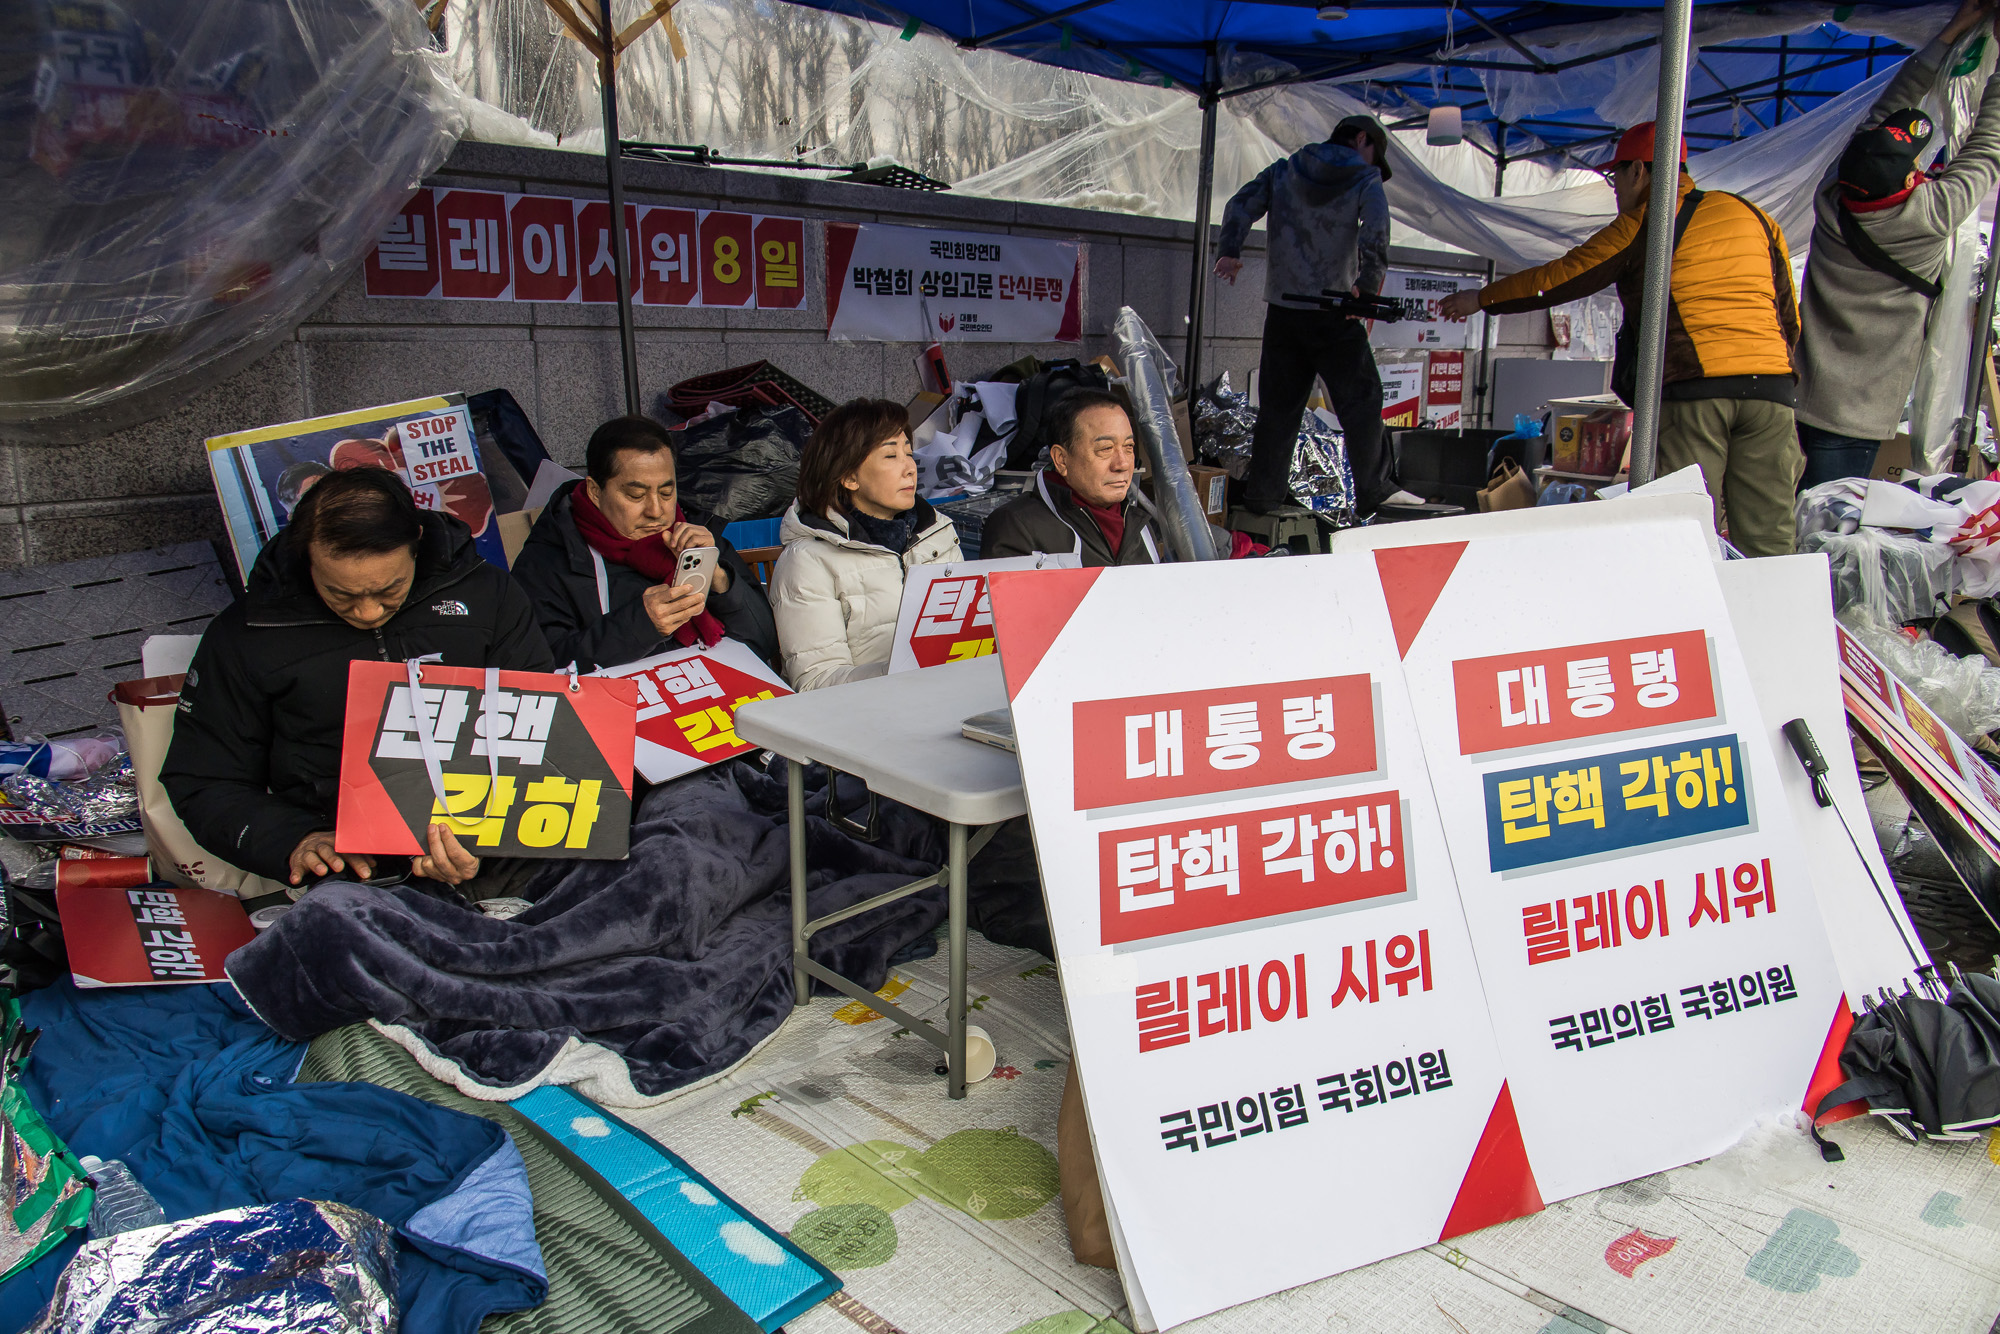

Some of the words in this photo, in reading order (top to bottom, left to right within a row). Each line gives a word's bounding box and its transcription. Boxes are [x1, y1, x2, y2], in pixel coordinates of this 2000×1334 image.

[930, 240, 1000, 262] 국민희망연대
[853, 267, 912, 296] 박철희
[919, 270, 993, 299] 상임고문
[999, 274, 1063, 303] 단식투쟁
[407, 416, 457, 439] STOP
[418, 437, 457, 458] THE
[413, 456, 473, 481] STEAL
[914, 579, 993, 637] 탄
[375, 686, 558, 765] 탄핵
[429, 773, 602, 849] 각하
[1499, 766, 1605, 844] 탄핵
[1619, 746, 1736, 817] 각하!
[1117, 825, 1240, 913] 탄핵
[1261, 804, 1394, 883] 각하!
[127, 890, 187, 925] 탄핵
[1522, 879, 1669, 965] 릴레이
[1688, 858, 1776, 928] 시위
[144, 930, 206, 977] 각하!
[1136, 953, 1308, 1053] 릴레이
[1331, 929, 1433, 1009] 시위
[1549, 993, 1675, 1052] 국민의힘
[1680, 964, 1798, 1020] 국회의원
[1160, 1083, 1309, 1152] 국민의힘
[1317, 1048, 1453, 1114] 국회의원
